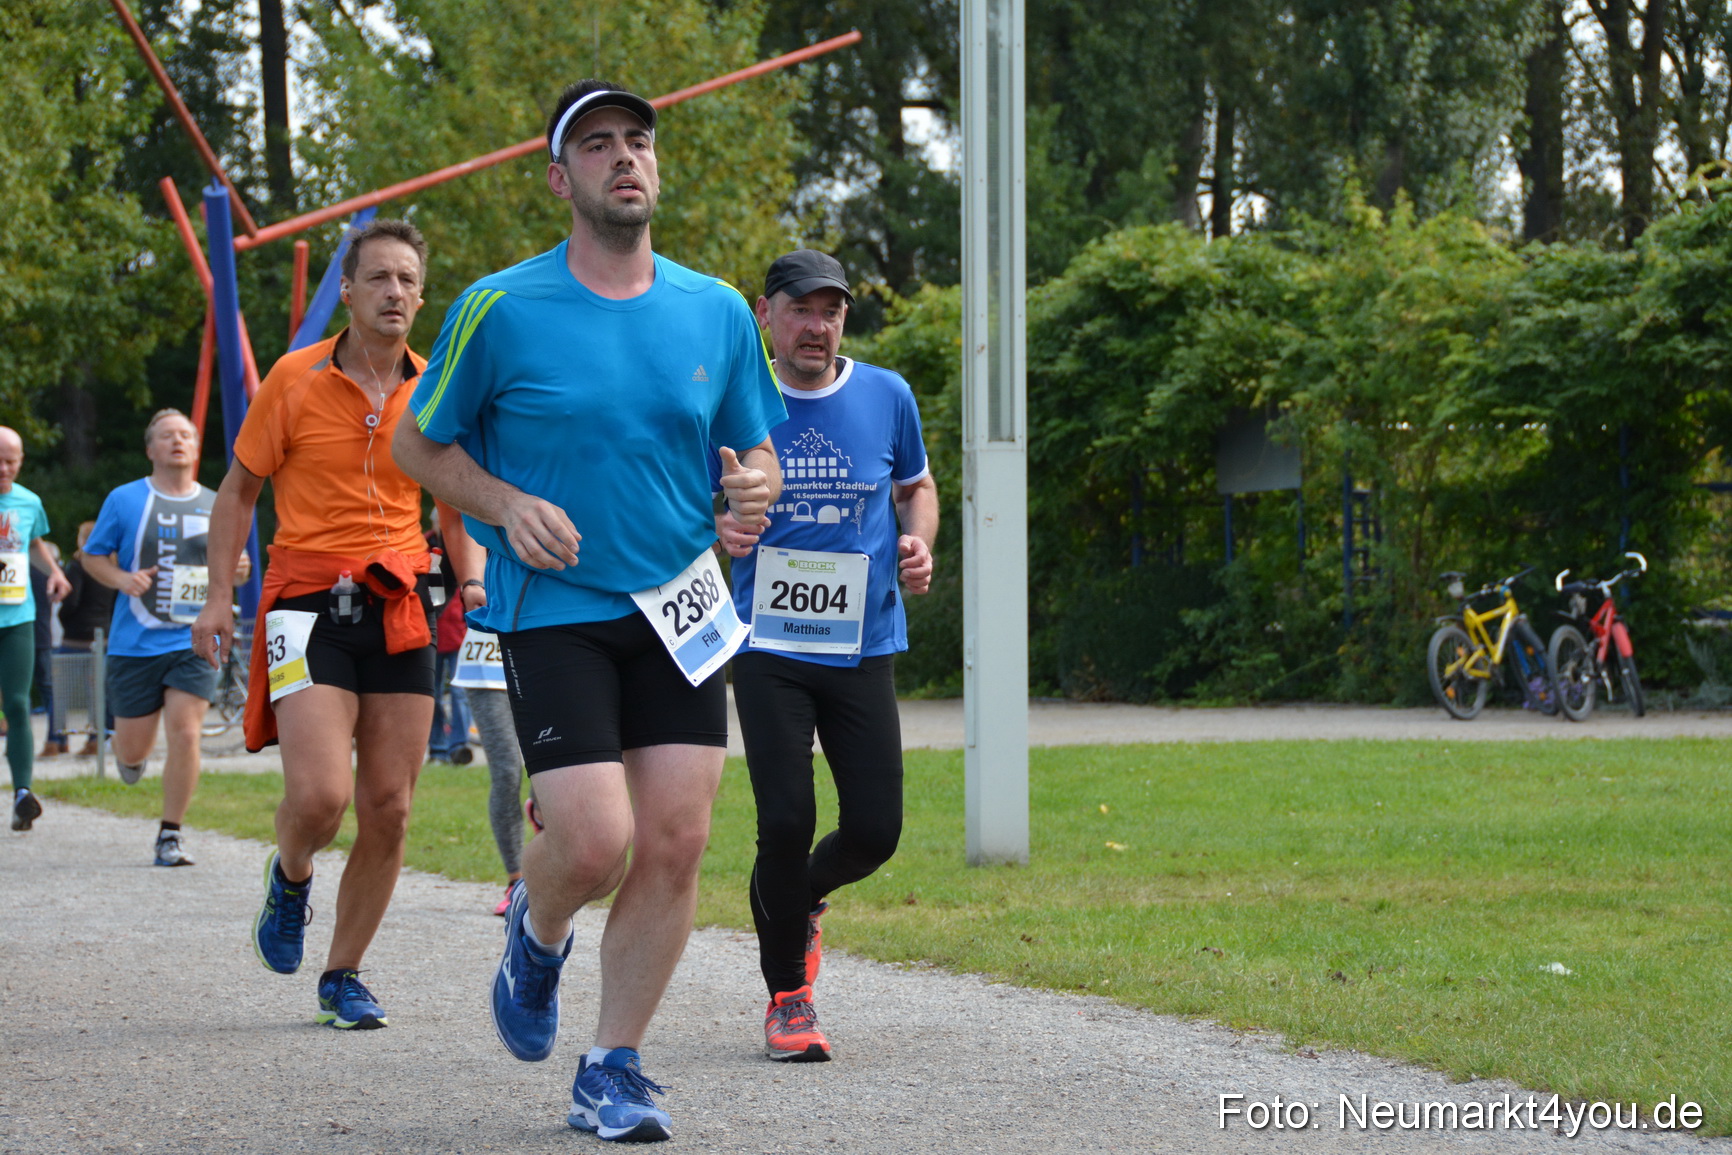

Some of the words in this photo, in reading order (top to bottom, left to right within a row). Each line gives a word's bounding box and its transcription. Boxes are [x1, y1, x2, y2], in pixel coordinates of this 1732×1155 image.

[782, 481, 832, 490] eumarkter
[835, 481, 878, 491] Stadtlauf
[155, 512, 178, 613] HIMATEC
[798, 560, 837, 570] BOCK
[180, 584, 208, 601] 219
[770, 580, 848, 613] 2604
[662, 568, 720, 637] 2388
[783, 622, 831, 635] Matthias
